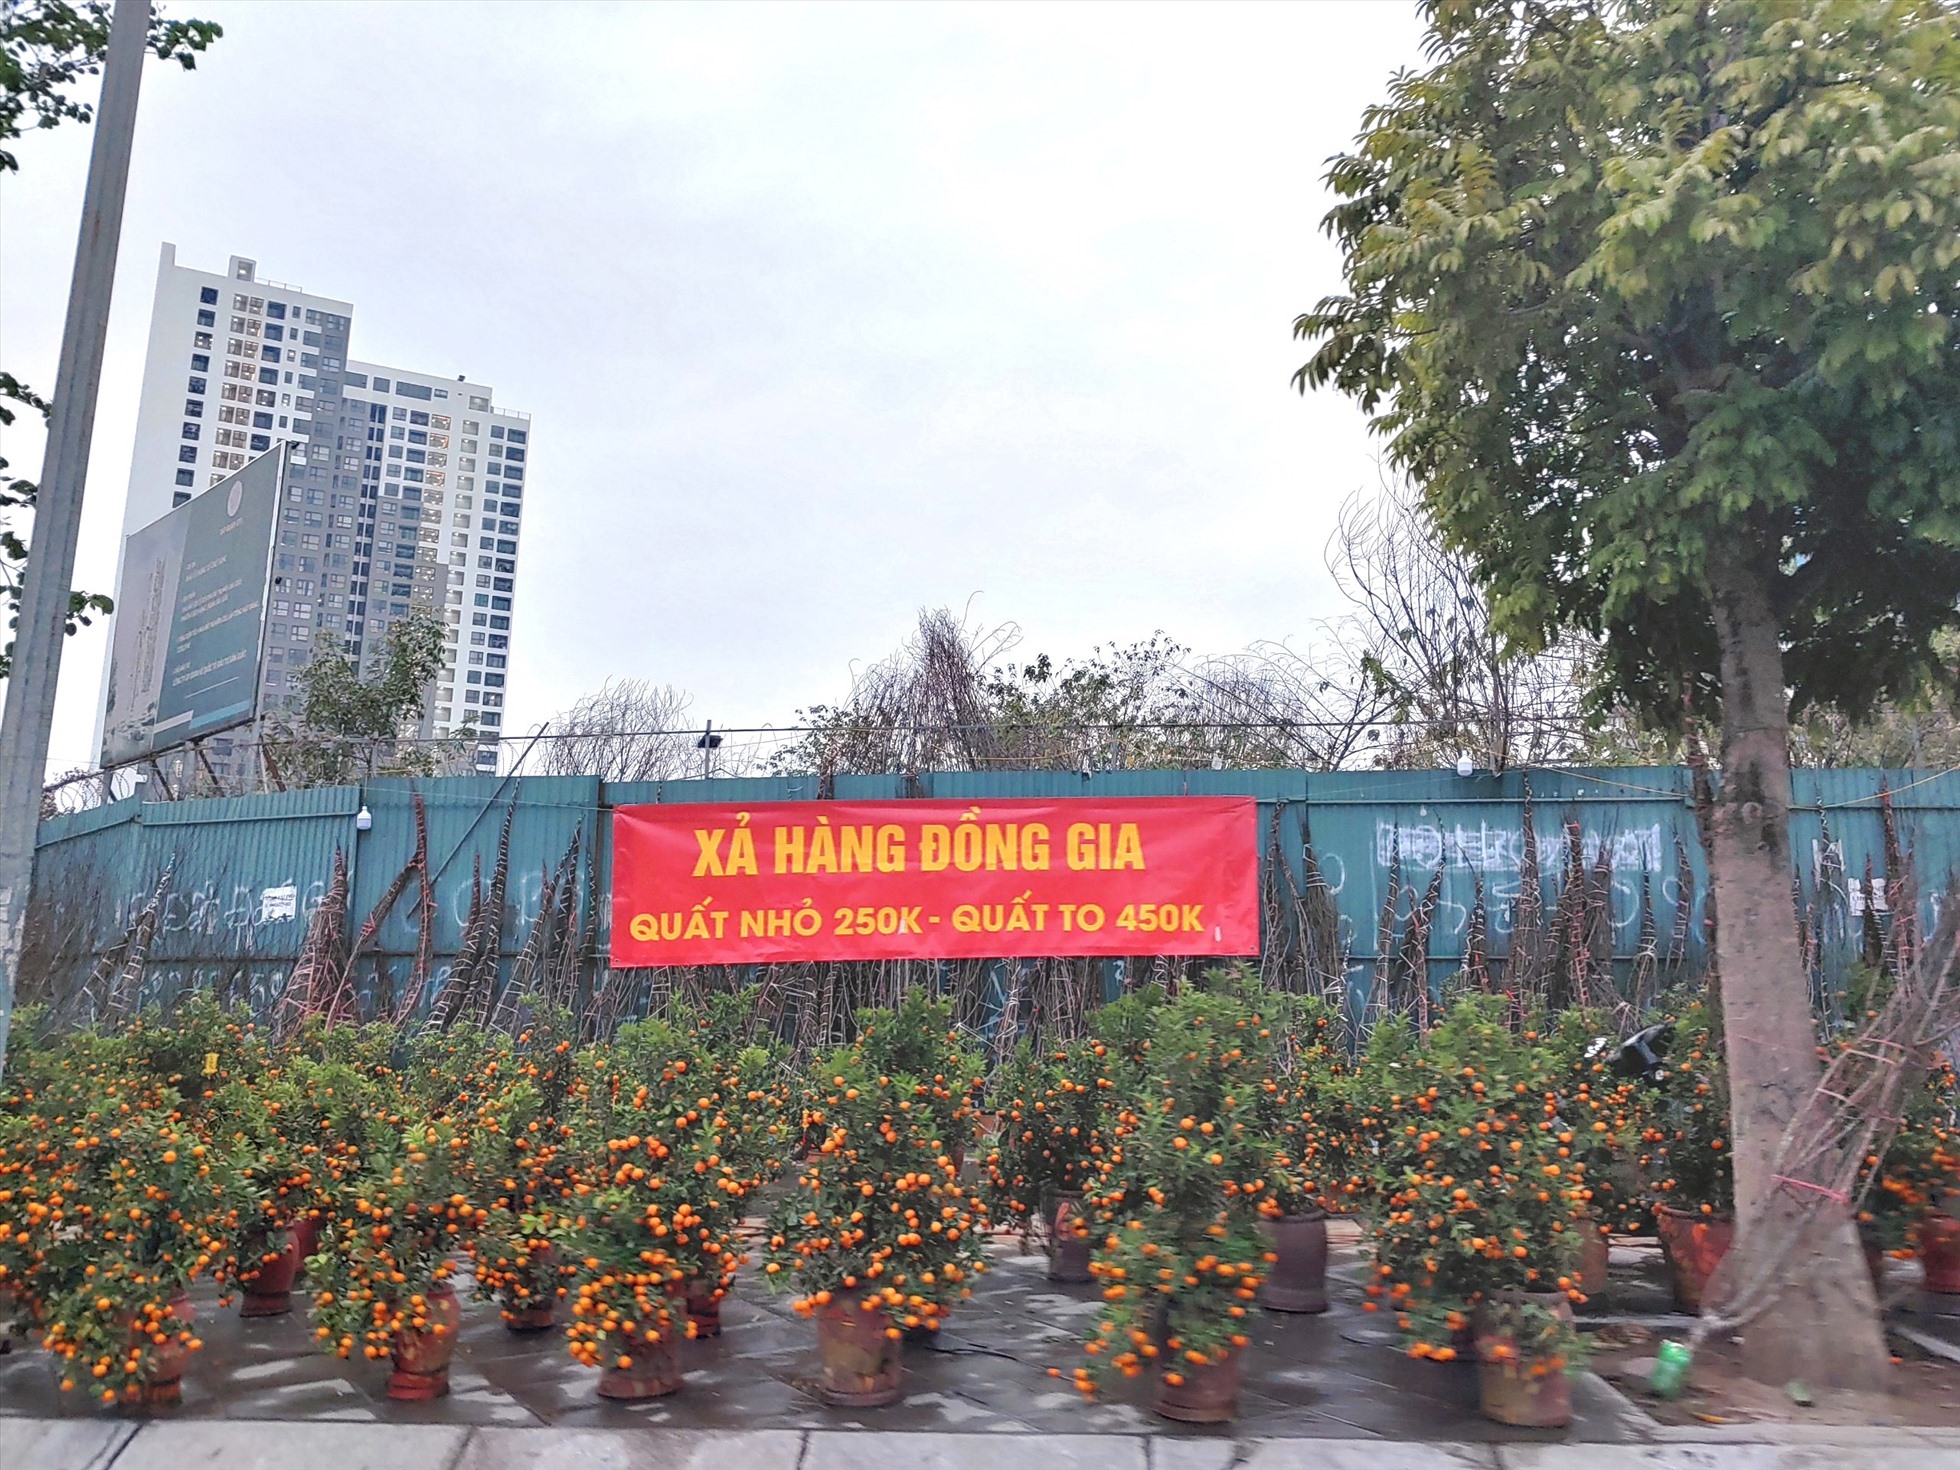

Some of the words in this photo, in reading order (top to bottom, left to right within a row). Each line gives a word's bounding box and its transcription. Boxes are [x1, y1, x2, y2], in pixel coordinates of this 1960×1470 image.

[692, 812, 759, 877] XẢ
[775, 816, 905, 875] HÀNG
[919, 806, 1050, 873] ĐỒNG
[1067, 823, 1145, 871] GIA
[629, 896, 729, 941] QUẤT
[740, 898, 823, 938] NHỎ
[832, 907, 922, 937] 250K
[951, 890, 1049, 932] QUẤT
[1059, 904, 1105, 932] TO
[1116, 904, 1204, 932] 450K
